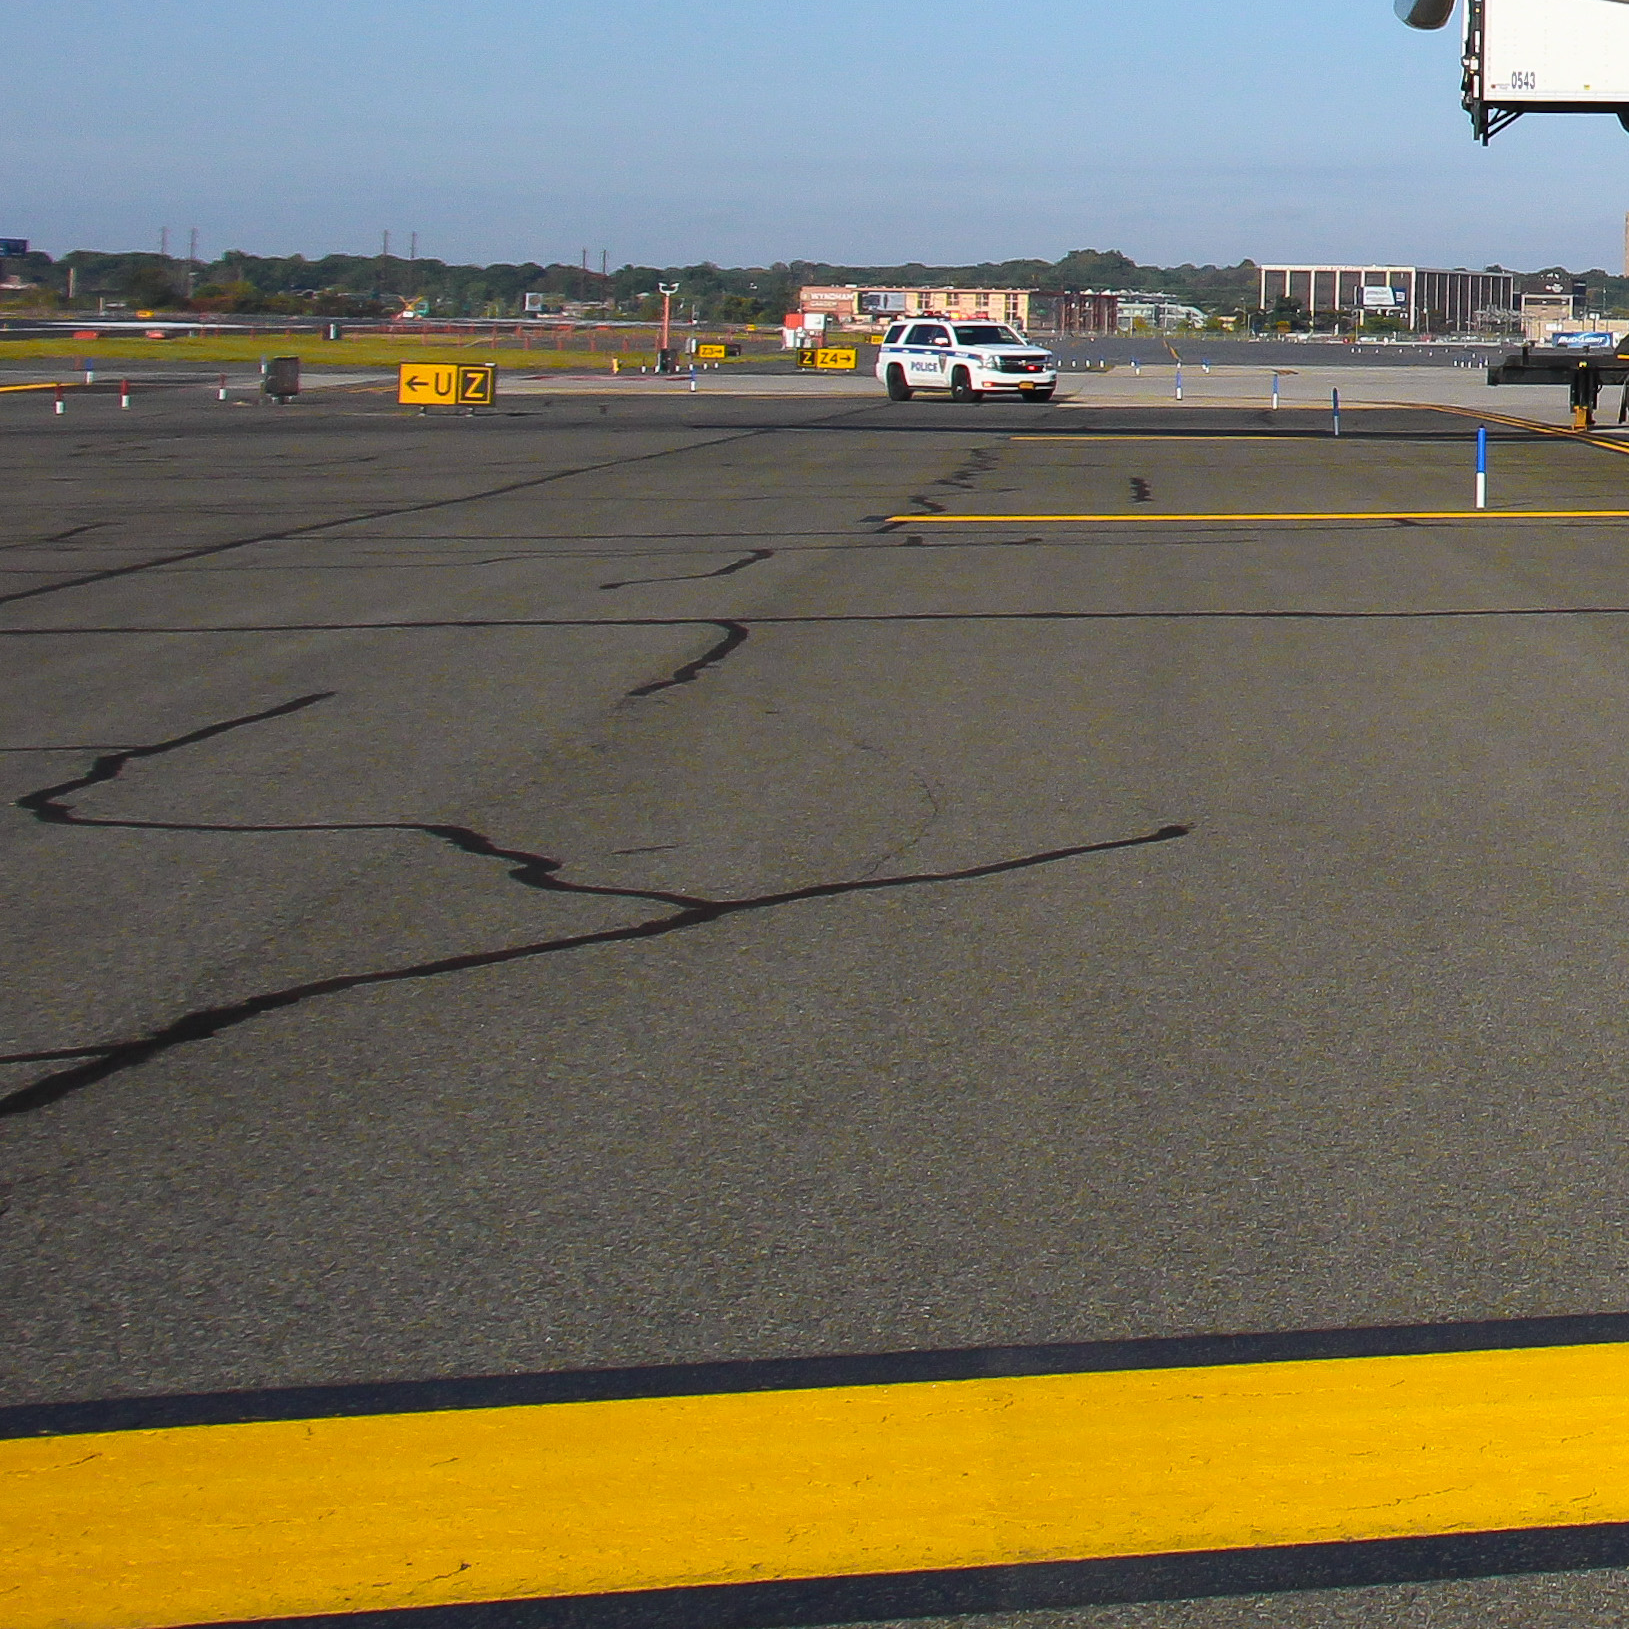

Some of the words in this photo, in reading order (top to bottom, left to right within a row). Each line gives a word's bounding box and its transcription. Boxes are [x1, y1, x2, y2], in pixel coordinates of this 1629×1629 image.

[1511, 71, 1536, 90] 0543
[802, 352, 813, 364] Z
[819, 352, 838, 365] Z4
[911, 361, 938, 373] POLICE
[434, 372, 452, 397] U
[464, 372, 486, 398] Z
